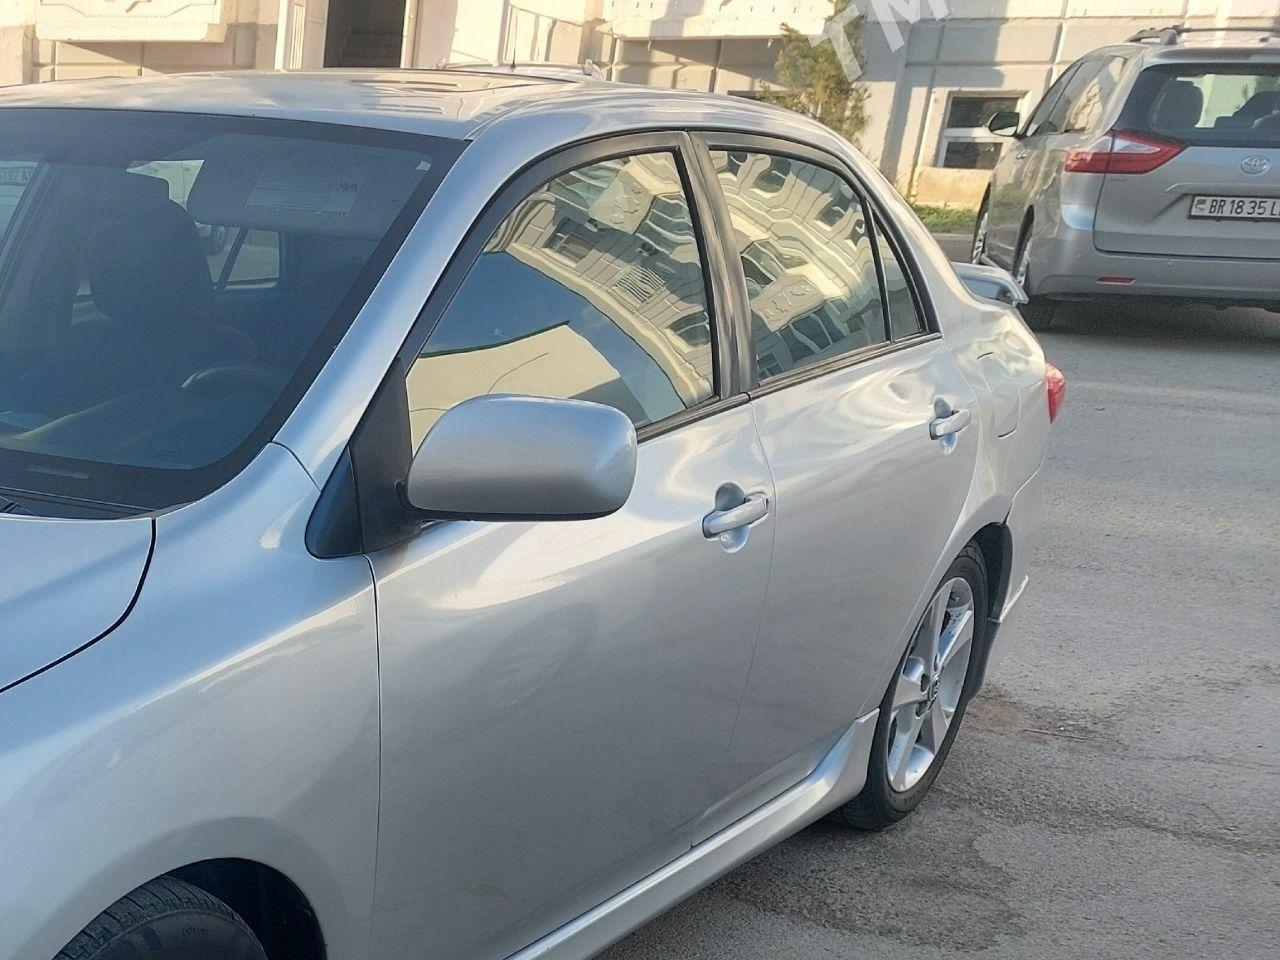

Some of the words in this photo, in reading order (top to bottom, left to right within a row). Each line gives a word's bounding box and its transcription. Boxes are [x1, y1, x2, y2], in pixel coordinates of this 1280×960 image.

[1209, 199, 1227, 215] BR
[1230, 200, 1245, 215] 18
[1247, 201, 1267, 216] 35
[1270, 201, 1280, 217] L
